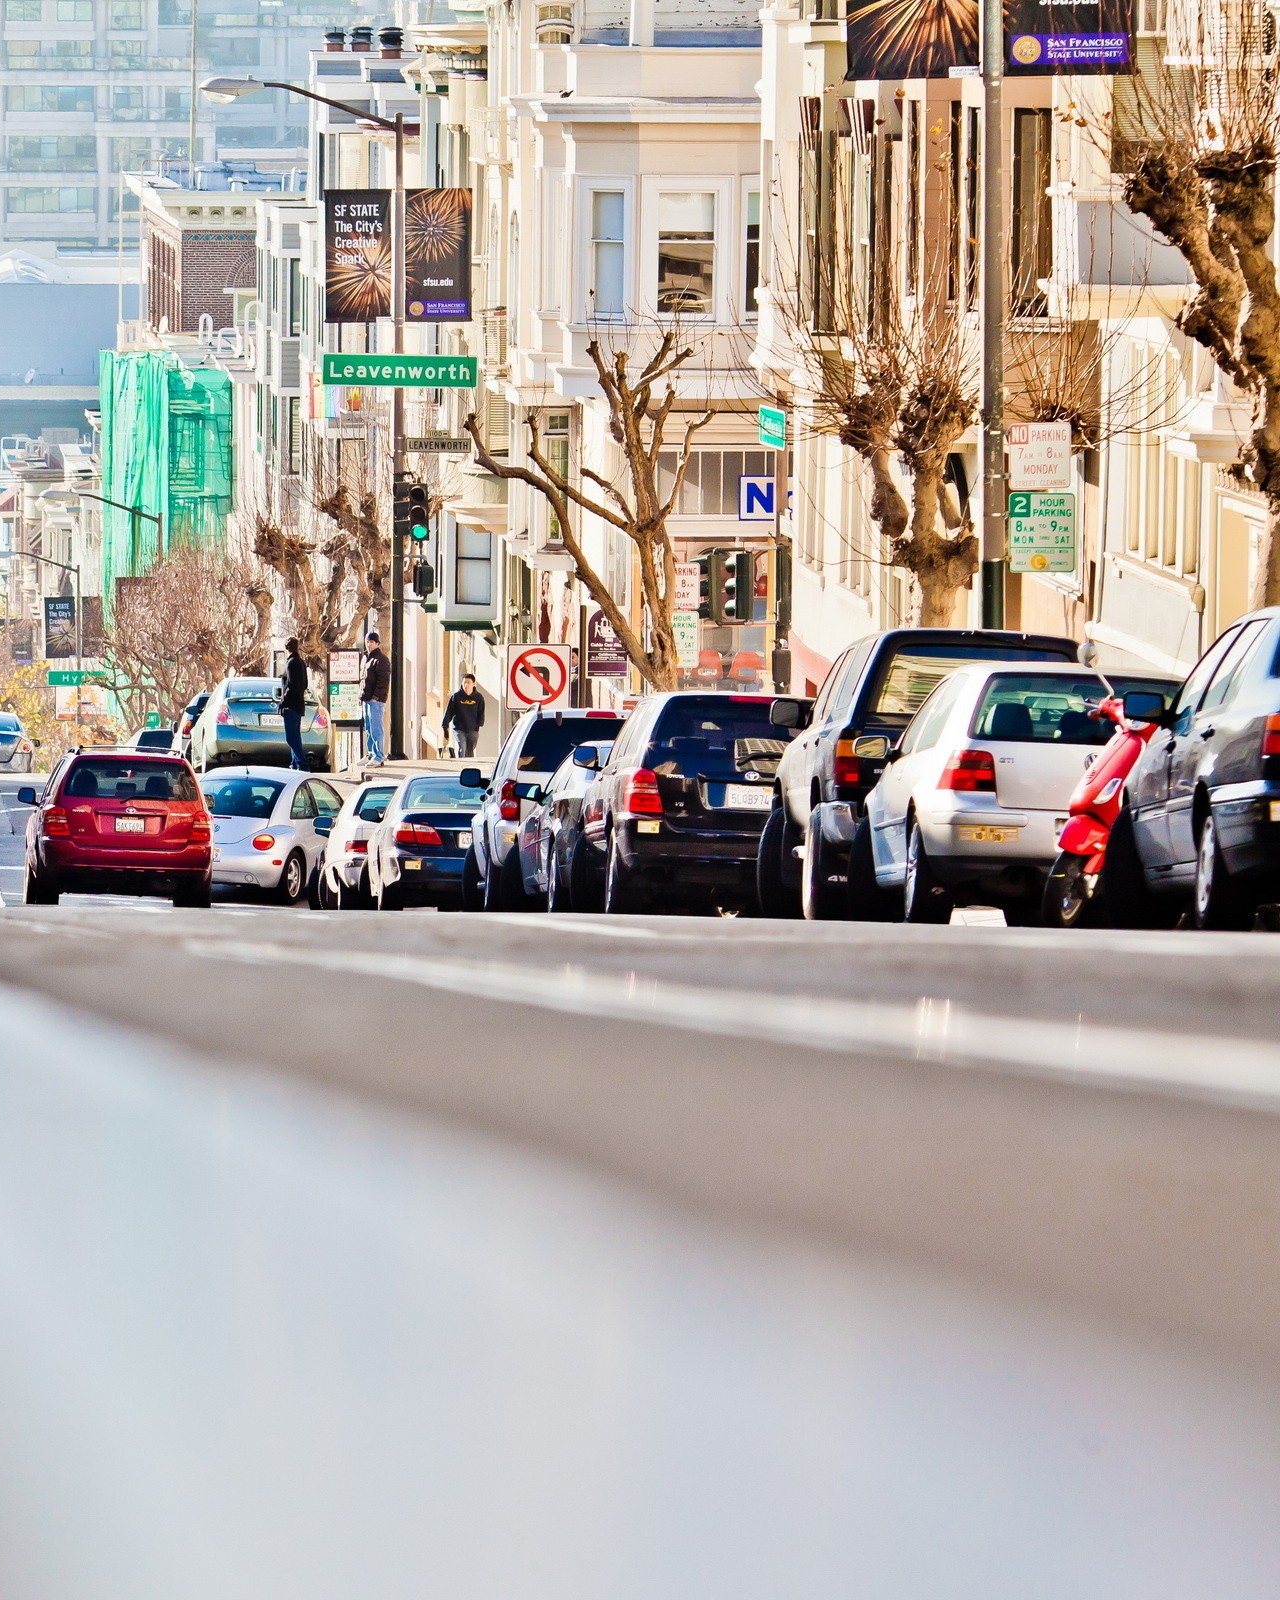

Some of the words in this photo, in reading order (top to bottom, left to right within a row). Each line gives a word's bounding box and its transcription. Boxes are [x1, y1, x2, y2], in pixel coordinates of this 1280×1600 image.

[1048, 38, 1066, 48] SAN
[1070, 38, 1123, 46] FRANCISCO
[1074, 50, 1122, 58] UNIVERSITY
[334, 204, 347, 216] SF
[350, 204, 379, 216] STATE
[335, 221, 352, 232] The
[356, 220, 383, 234] City's
[335, 237, 377, 249] Creative
[335, 253, 365, 266] Spark
[423, 278, 453, 287] sfsu.edu
[330, 362, 470, 380] Leavenworth
[1012, 426, 1026, 442] NO
[1032, 429, 1066, 442] PARKING
[409, 441, 468, 450] LEAVENWORTH
[1024, 464, 1058, 474] MONDAY
[1014, 496, 1027, 513] 2
[1033, 508, 1072, 517] PARKING
[1055, 536, 1070, 544] SAT
[332, 686, 338, 694] 2
